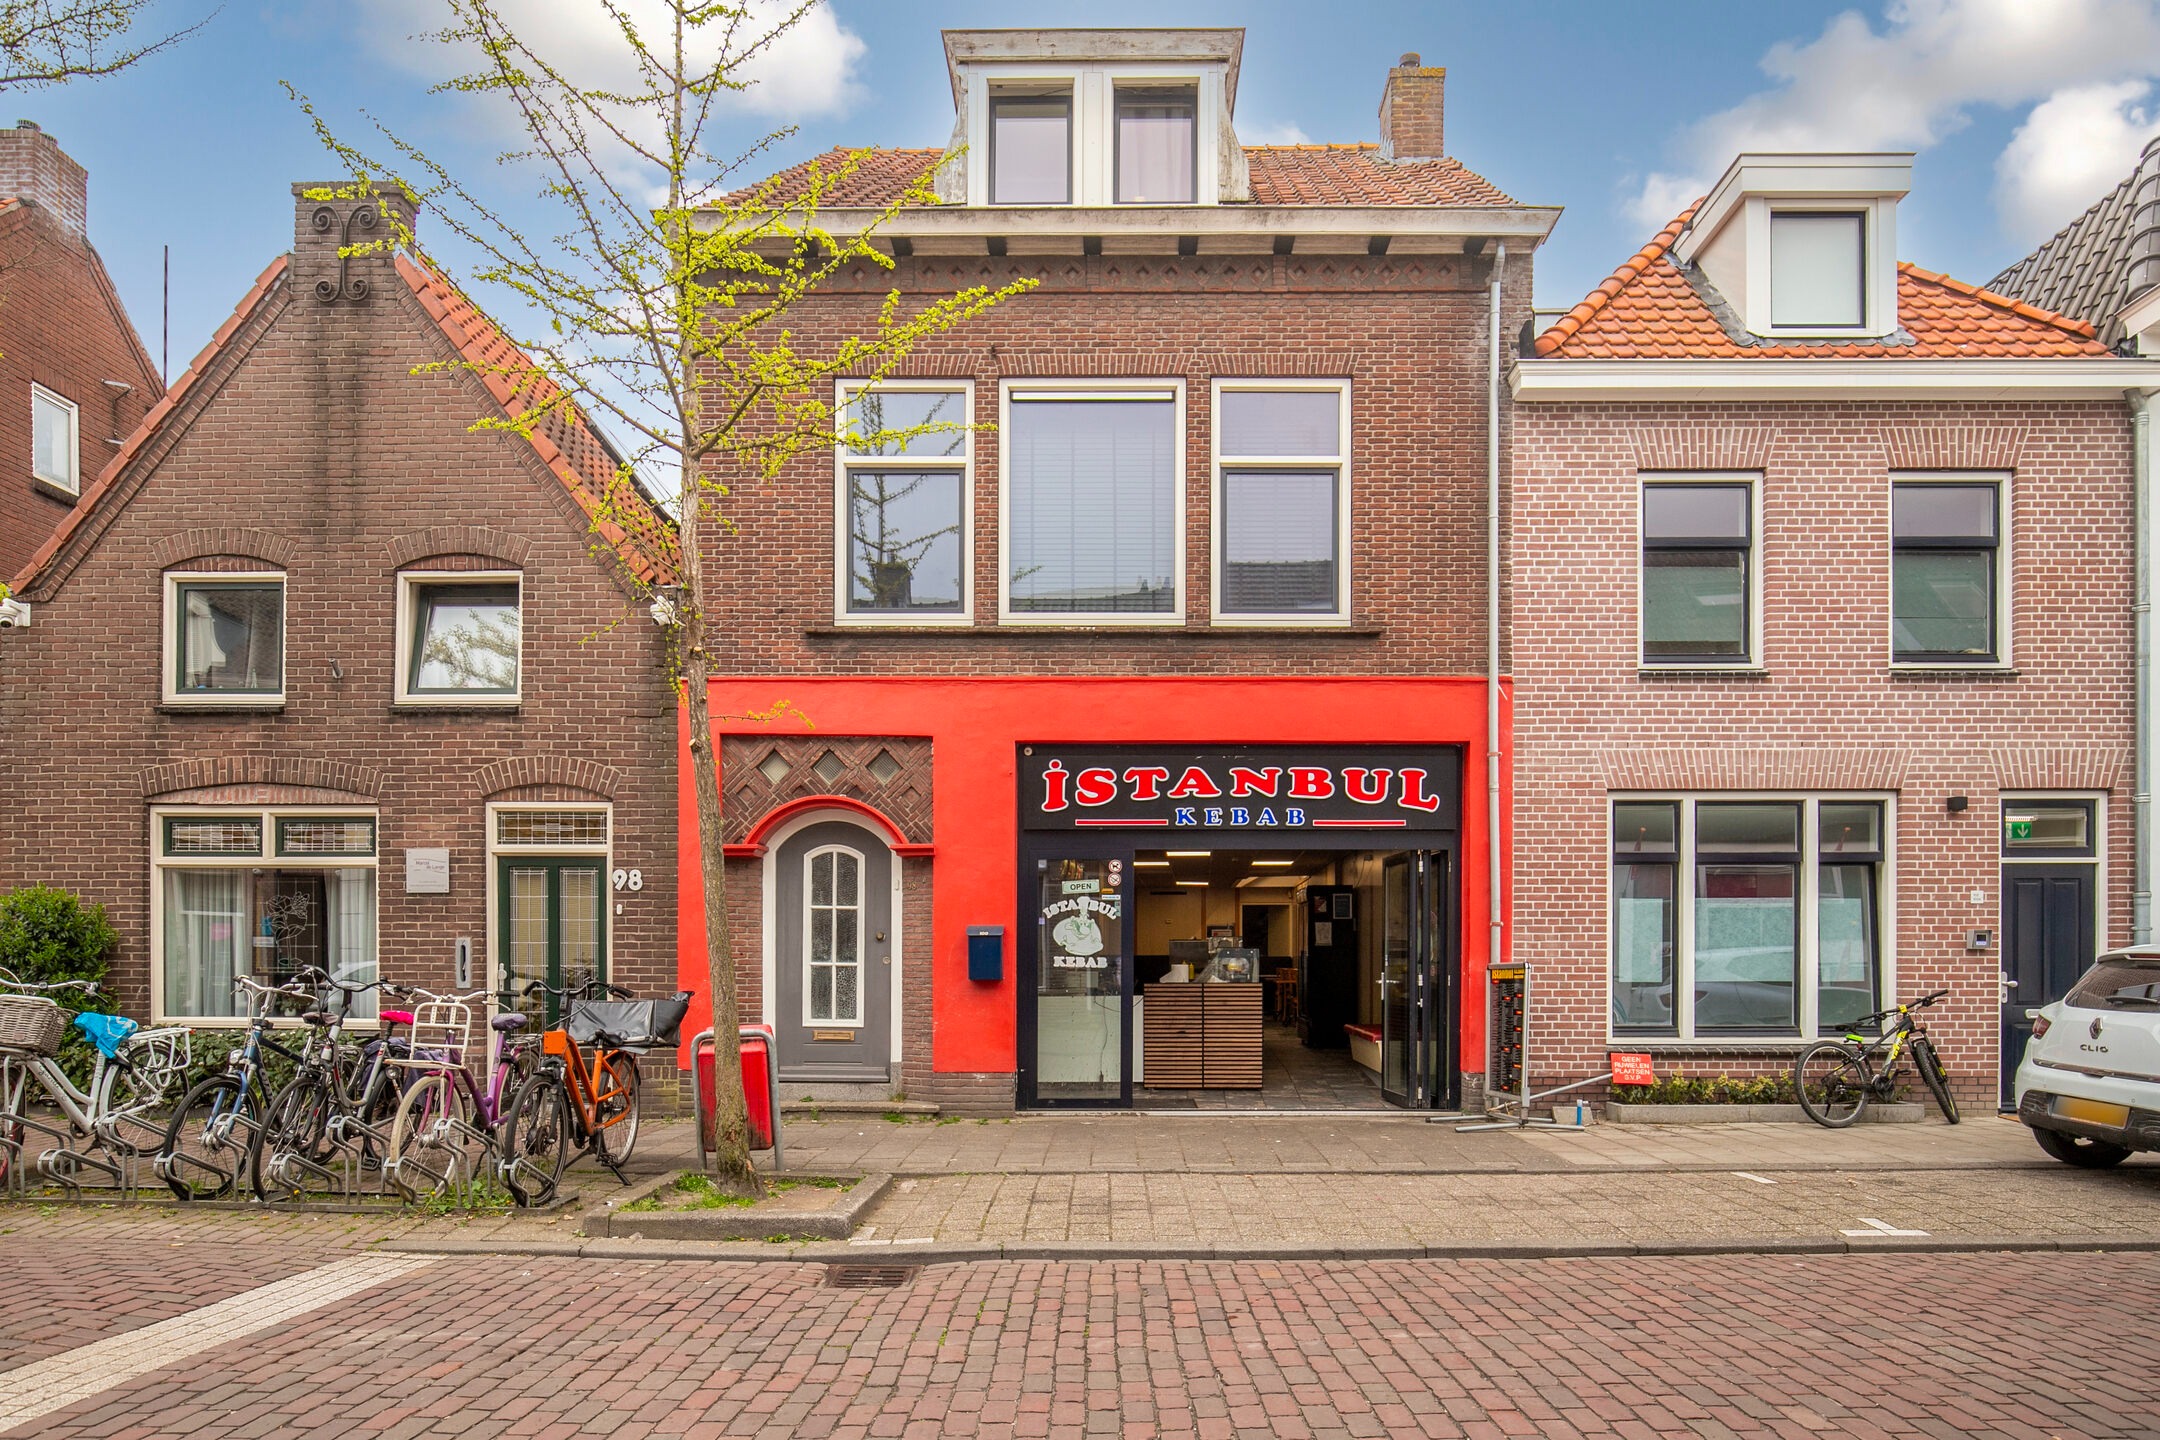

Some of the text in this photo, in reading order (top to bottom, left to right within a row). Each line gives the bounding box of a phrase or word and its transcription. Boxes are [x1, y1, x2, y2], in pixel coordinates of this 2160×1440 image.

[1175, 807, 1305, 827] KEBAB
[612, 869, 643, 891] 98
[1070, 883, 1092, 891] OPEN
[1043, 897, 1117, 920] ISTABUL
[1053, 956, 1108, 968] KEBAB
[2080, 1044, 2109, 1053] CLIO
